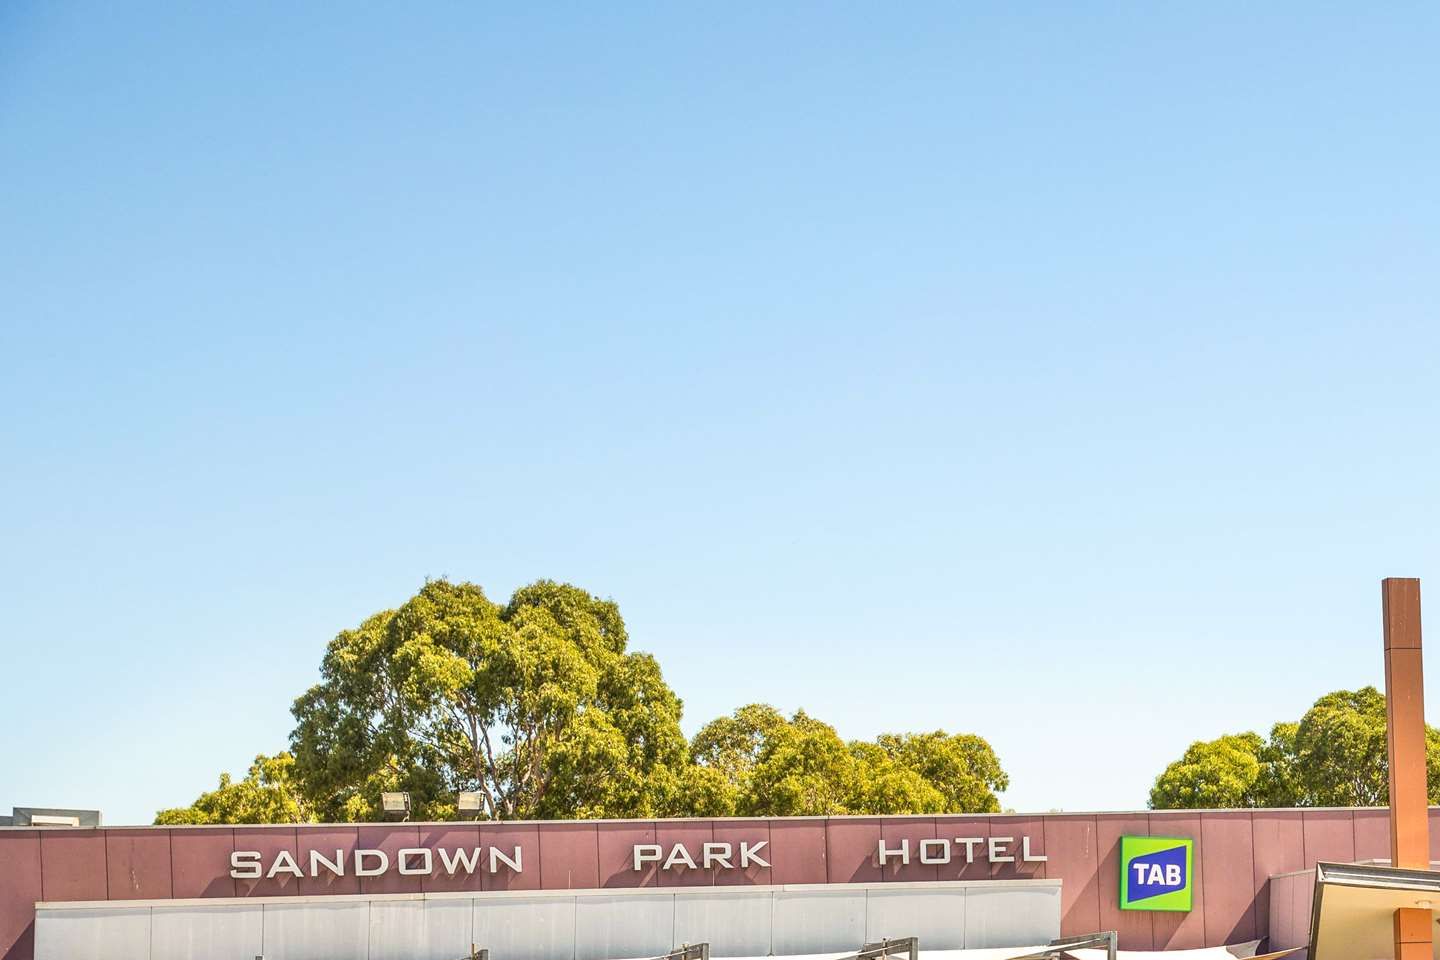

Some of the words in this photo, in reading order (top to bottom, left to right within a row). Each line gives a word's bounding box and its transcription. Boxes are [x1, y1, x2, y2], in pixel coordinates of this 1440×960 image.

[230, 846, 522, 879] SANDOWN
[633, 841, 772, 871] PARK
[878, 836, 1048, 865] HOTEL
[1132, 863, 1181, 886] TAB
